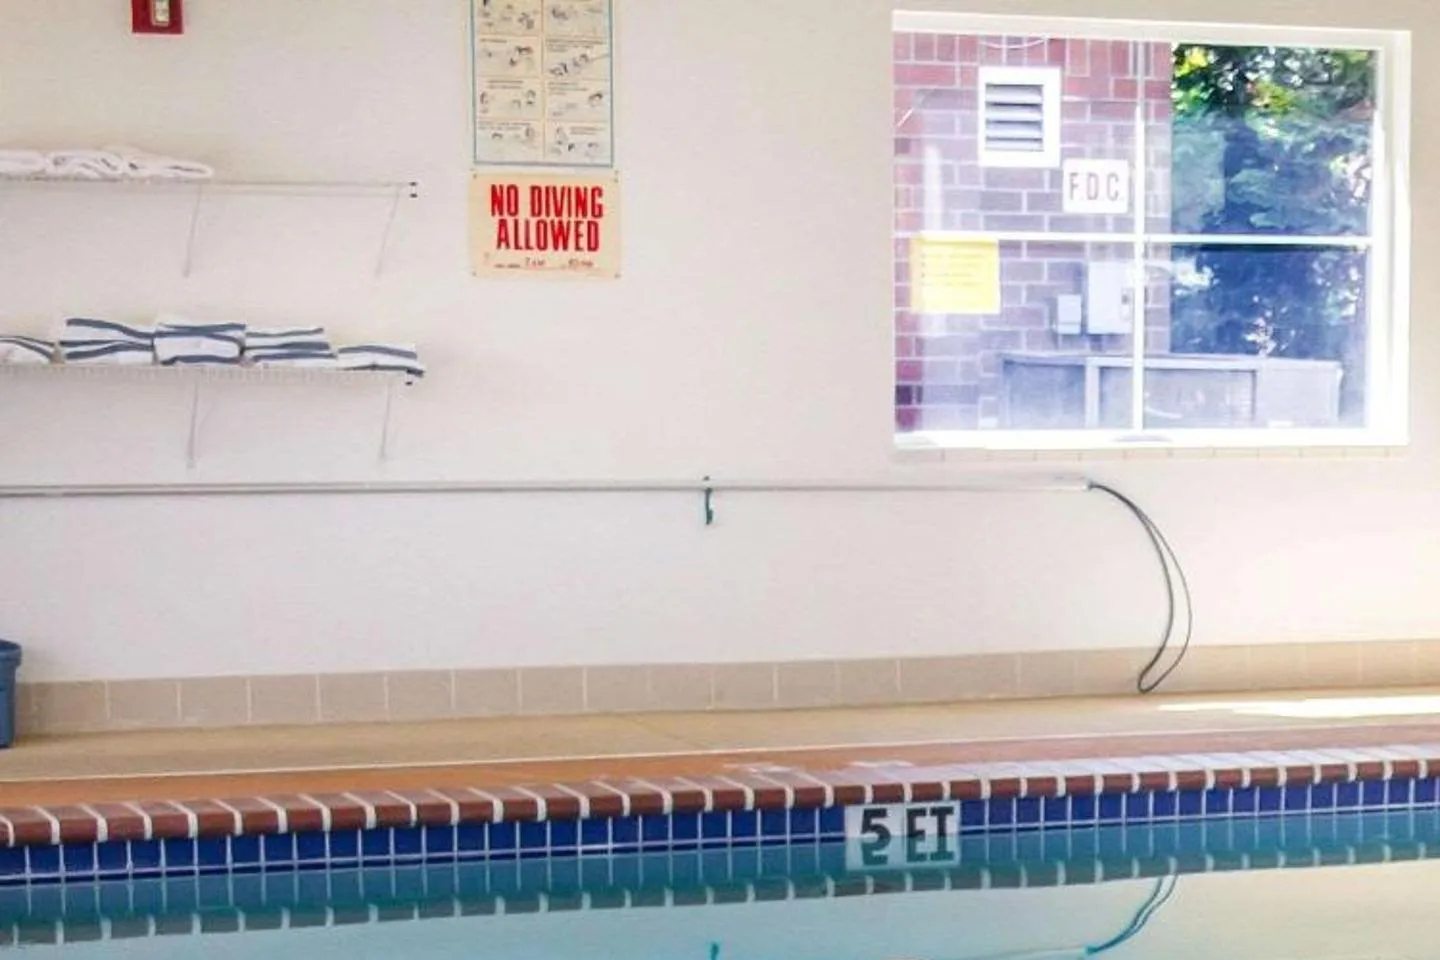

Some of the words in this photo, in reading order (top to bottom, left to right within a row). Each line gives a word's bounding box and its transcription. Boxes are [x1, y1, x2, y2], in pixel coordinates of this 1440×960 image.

[490, 184, 519, 217] NO
[529, 185, 604, 218] DIVING
[496, 218, 600, 252] ALLOWED
[861, 808, 891, 842] 5
